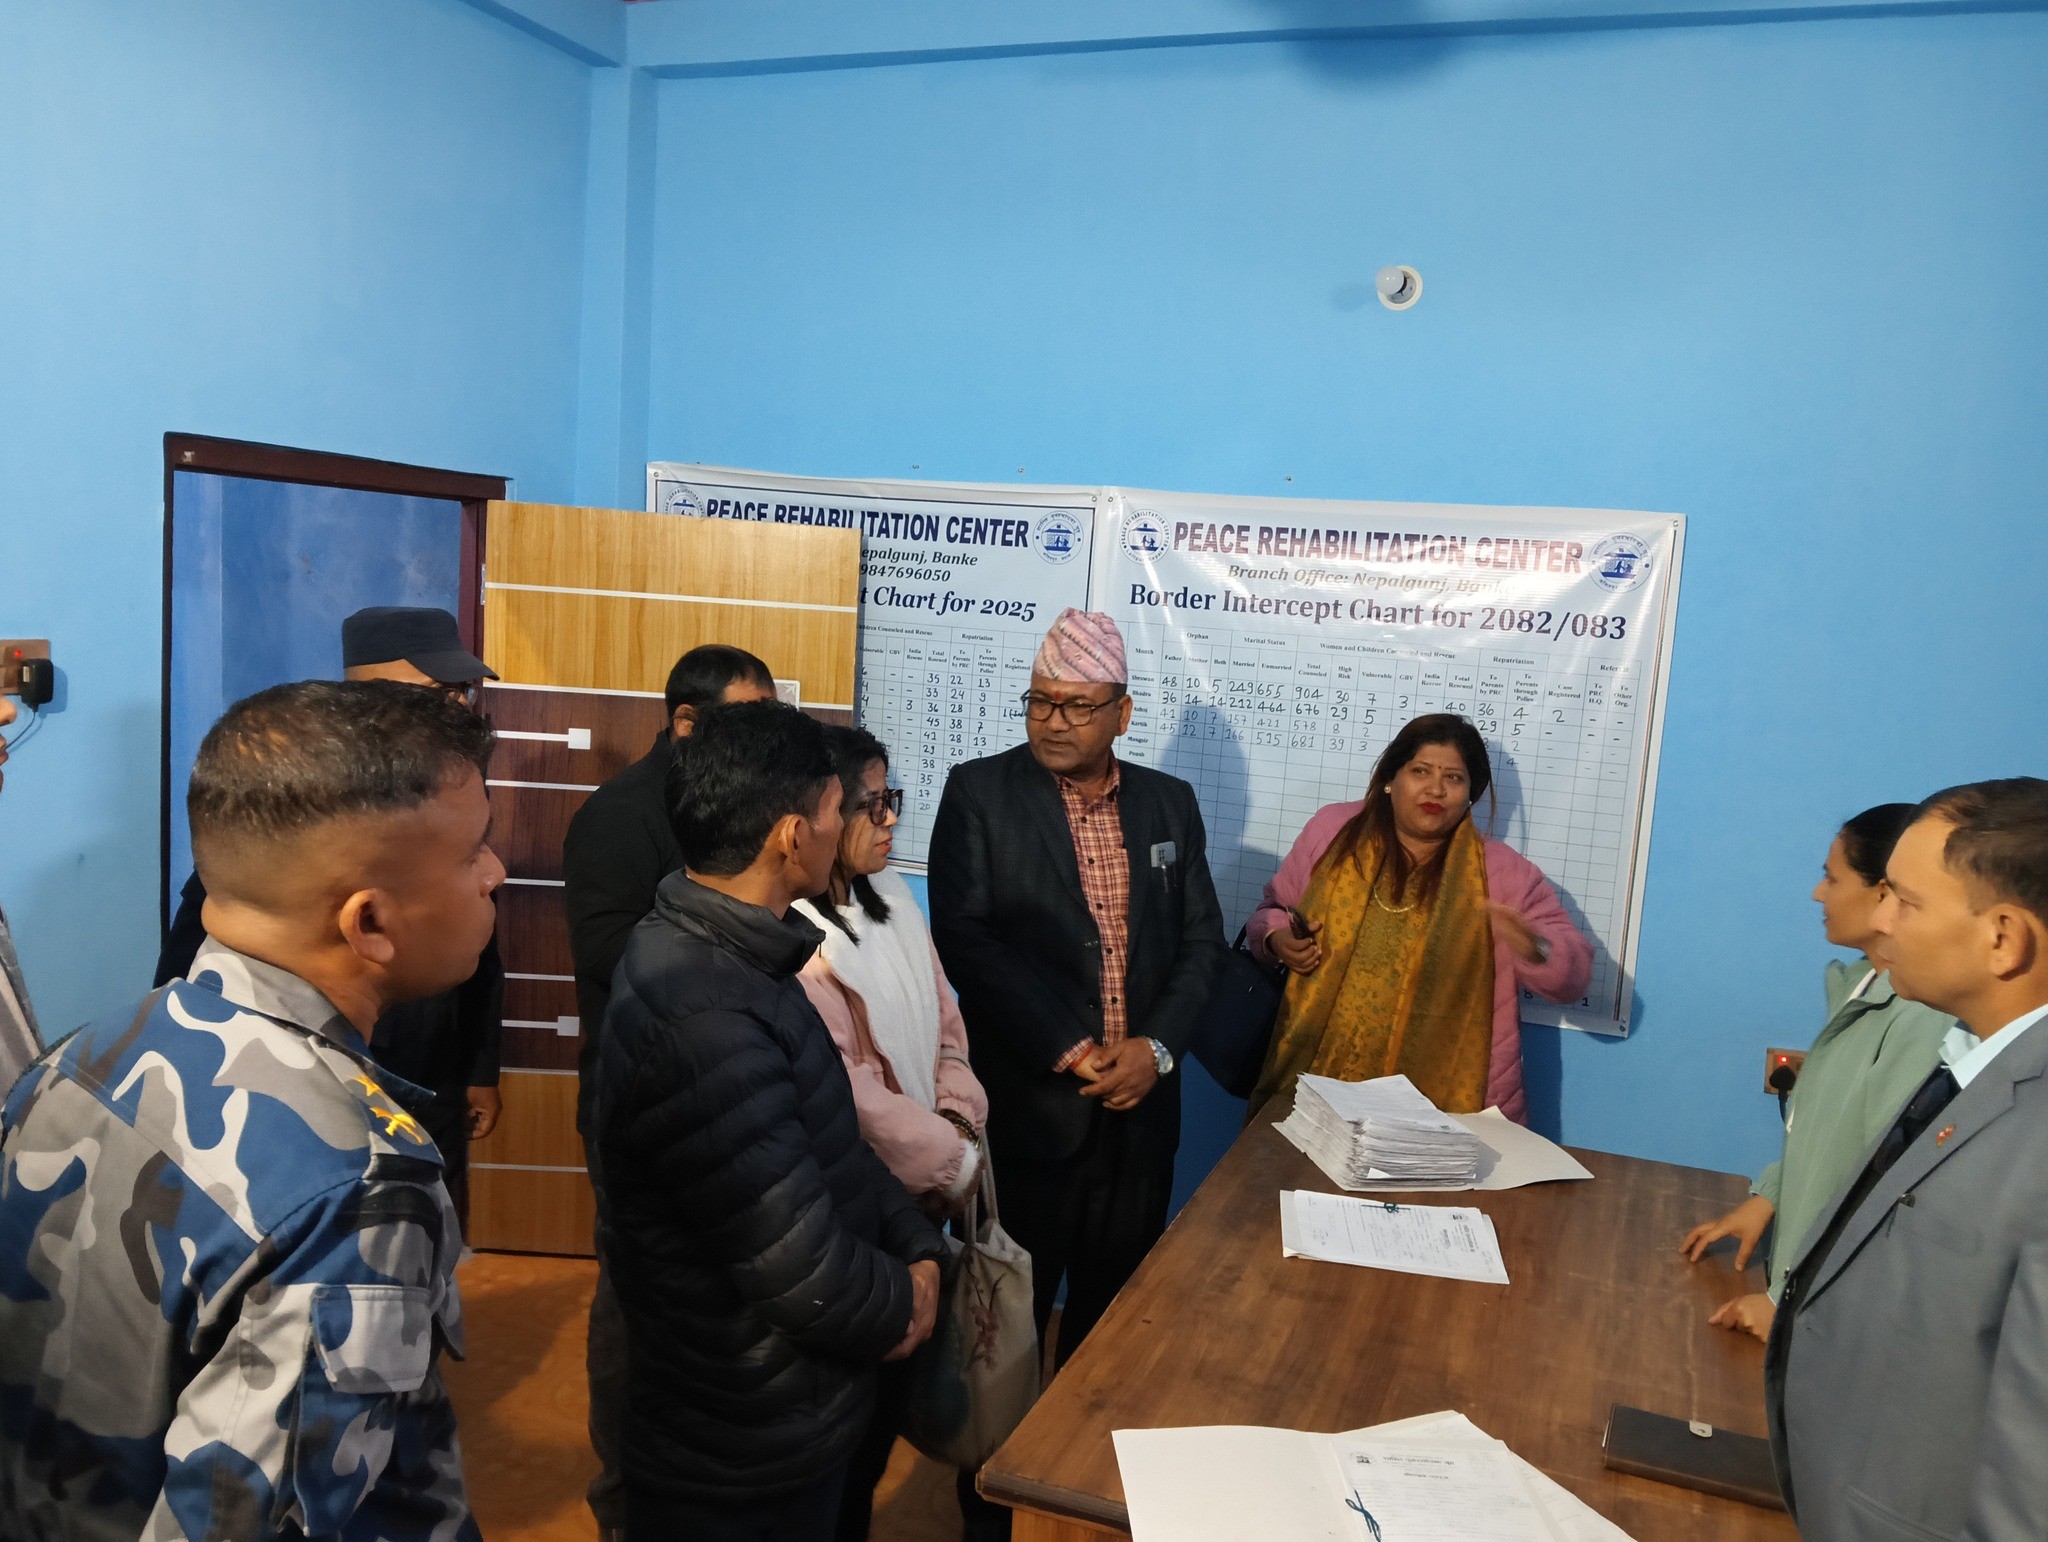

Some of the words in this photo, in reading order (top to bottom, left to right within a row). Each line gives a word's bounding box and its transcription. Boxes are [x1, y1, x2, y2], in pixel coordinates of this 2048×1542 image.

[946, 516, 1029, 548] CENTER
[1173, 521, 1251, 554] PEACE
[1257, 526, 1467, 567] REHABILITATION
[1475, 536, 1584, 574] CENTER
[861, 547, 928, 565] epalgunj,
[932, 551, 978, 566] Banke
[860, 564, 951, 582] 9847696050
[1227, 564, 1289, 581] Branch
[1293, 568, 1349, 587] Office:
[1353, 572, 1451, 594] Nepalgunj,
[874, 585, 937, 610] Chart
[936, 590, 975, 616] for
[980, 598, 1037, 622] 2025
[1129, 583, 1216, 611] Border
[1222, 590, 1343, 624] Intercept
[1349, 598, 1425, 626] Chart
[1432, 603, 1472, 630] for
[1480, 607, 1628, 641] 2082/083
[961, 633, 993, 642] Repatriation
[1186, 632, 1209, 640] Orphan
[1266, 638, 1286, 646] Status
[1319, 642, 1343, 651] Women
[1357, 646, 1385, 654] Children
[1232, 660, 1255, 668] Married
[1493, 656, 1535, 665] Repatriation
[1261, 663, 1292, 671] Unmarried
[1338, 665, 1352, 673] High
[1298, 670, 1328, 678] Counseled
[1361, 672, 1392, 680] Vulnerable
[927, 673, 940, 684] 35
[950, 675, 964, 685] 22
[978, 678, 991, 688] 13
[1480, 681, 1504, 689] Parents
[1515, 680, 1539, 688] Parents
[925, 685, 939, 698] 33
[951, 688, 964, 700] 24
[979, 692, 987, 703] 9
[1479, 688, 1488, 696] by
[1513, 688, 1539, 696] through
[1548, 690, 1581, 699] Registered
[1613, 692, 1633, 700] Other
[1162, 676, 1178, 687] 48
[1186, 677, 1201, 688] 10
[1212, 679, 1223, 693] 5
[1228, 680, 1254, 694] 249
[1257, 683, 1285, 698] 655
[1295, 687, 1324, 700] 904
[1336, 690, 1350, 704] 30
[1367, 693, 1377, 706] 7
[1399, 695, 1409, 708] 3
[1445, 702, 1466, 712] 40
[1478, 702, 1495, 716] 36
[1513, 706, 1530, 719] 4
[1552, 709, 1565, 723] 2
[1516, 695, 1535, 703] Police
[906, 700, 914, 711] 3
[927, 702, 939, 713] 36
[950, 703, 963, 714] 28
[979, 706, 987, 717] 8
[1162, 691, 1177, 703] 36
[1184, 693, 1202, 706] 14
[1208, 696, 1226, 707] 14
[1229, 697, 1253, 709] 212
[1257, 701, 1286, 713] 464
[1296, 703, 1320, 716] 676
[1330, 706, 1348, 720] 29
[1363, 709, 1377, 724] 5
[1477, 720, 1497, 733] 29
[1511, 723, 1525, 736] 5
[926, 716, 940, 727] 45
[950, 719, 963, 730] 38
[977, 721, 984, 734] 7
[1131, 719, 1148, 727] Kartik
[1160, 708, 1176, 719] 41
[1183, 710, 1198, 721] 10
[1210, 712, 1218, 724] 7
[1227, 713, 1247, 725] 157
[1257, 716, 1280, 728] 421
[1293, 719, 1317, 731] 578
[1332, 723, 1340, 734] 8
[1363, 727, 1371, 738] 2
[1512, 740, 1520, 752] 2
[923, 731, 937, 741] 41
[949, 733, 962, 744] 28
[973, 736, 987, 747] 13
[1127, 736, 1149, 744] Mangsir
[1160, 723, 1178, 735] 45
[1182, 724, 1197, 737] 12
[1209, 727, 1216, 738] 7
[1225, 728, 1245, 741] 166
[1256, 732, 1283, 746] 515
[1291, 735, 1315, 748] 681
[1329, 738, 1345, 751] 39
[1358, 741, 1368, 751] 3
[1506, 757, 1519, 768] 4
[950, 747, 963, 756] 20
[978, 750, 983, 759] 9
[922, 759, 936, 769] 38
[920, 774, 933, 785] 35
[918, 789, 930, 798] 17
[919, 803, 931, 811] 20
